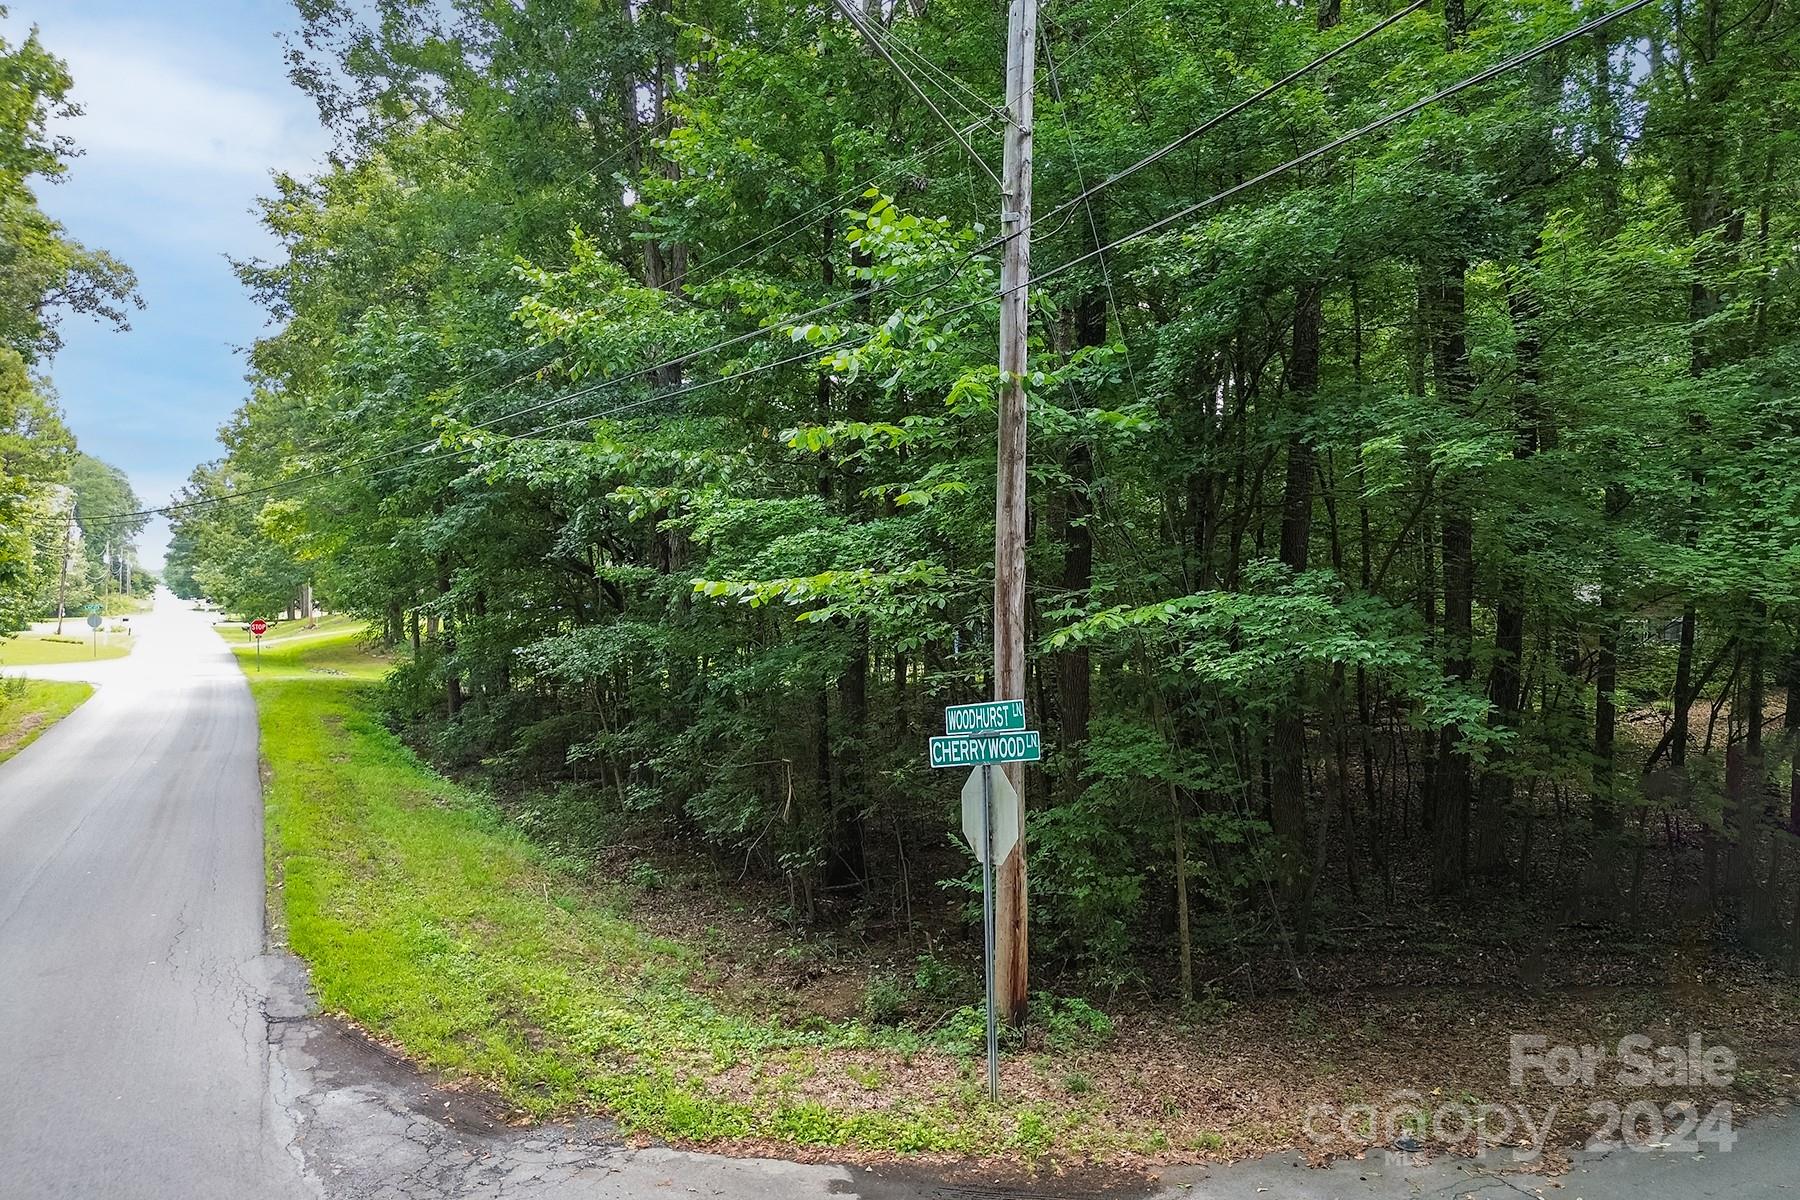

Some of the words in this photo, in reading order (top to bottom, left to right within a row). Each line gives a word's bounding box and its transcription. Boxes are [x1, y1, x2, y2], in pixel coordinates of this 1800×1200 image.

[252, 623, 266, 631] STOP
[948, 706, 1009, 731] WOODHURST
[1012, 702, 1023, 717] LN
[932, 737, 1025, 763] CHERRYWOOD
[1025, 733, 1038, 748] LN
